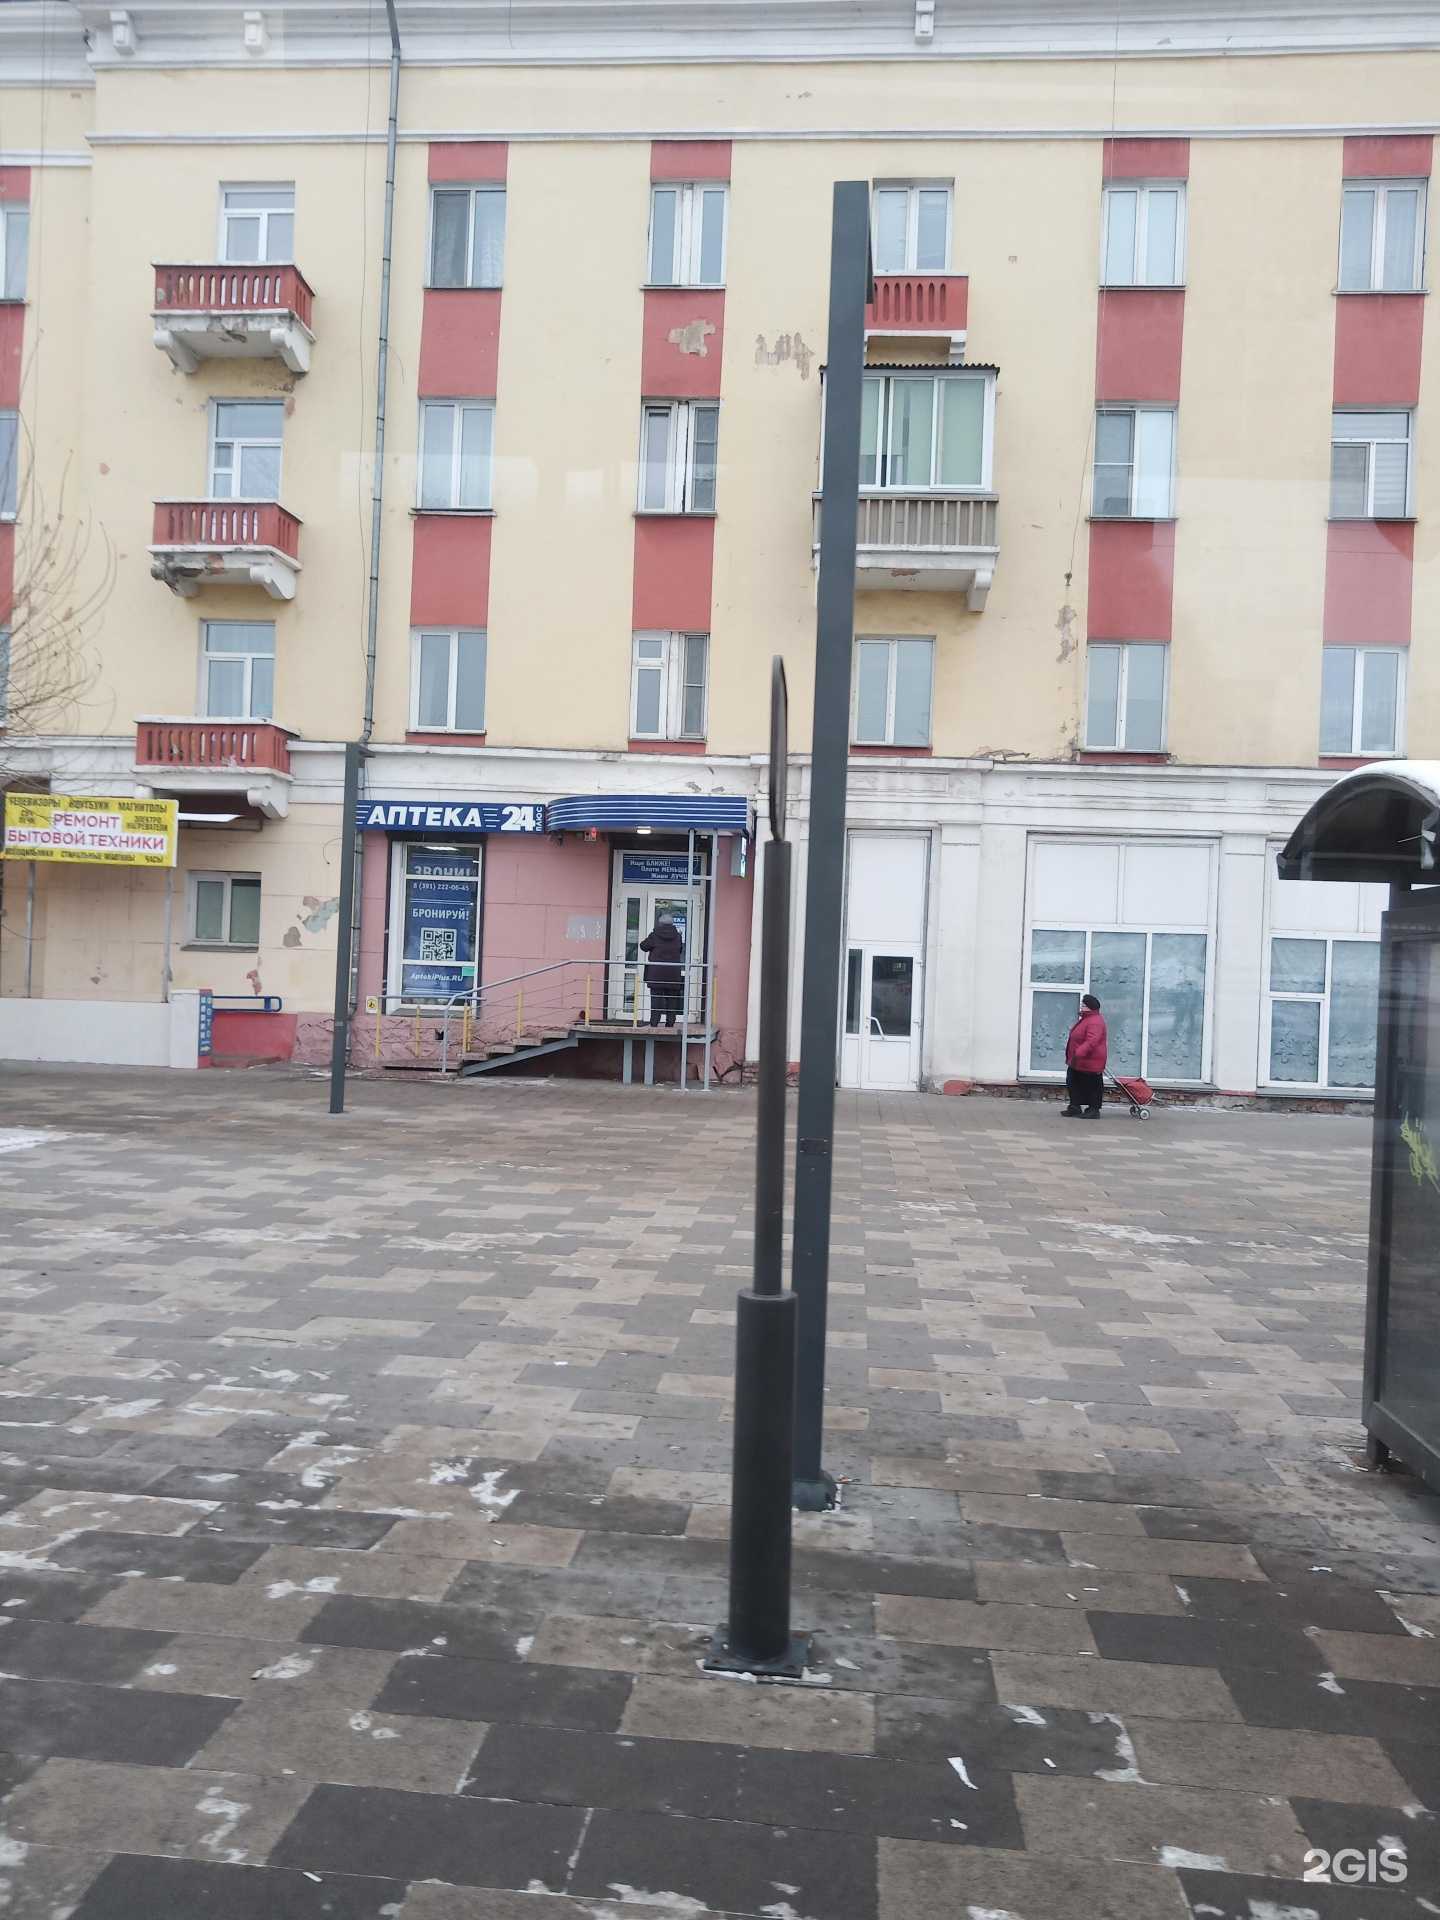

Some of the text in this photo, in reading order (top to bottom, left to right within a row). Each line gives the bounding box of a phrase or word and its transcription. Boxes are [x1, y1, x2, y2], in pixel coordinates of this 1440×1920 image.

[53, 813, 120, 829] РЕМОНТ
[366, 805, 535, 832] АПТЕКА 24
[535, 806, 543, 832] ПЛЮС
[8, 829, 164, 850] БЫТОВОЙ ТЕХНИКИ
[412, 908, 469, 921] БРОНИРУЙ!
